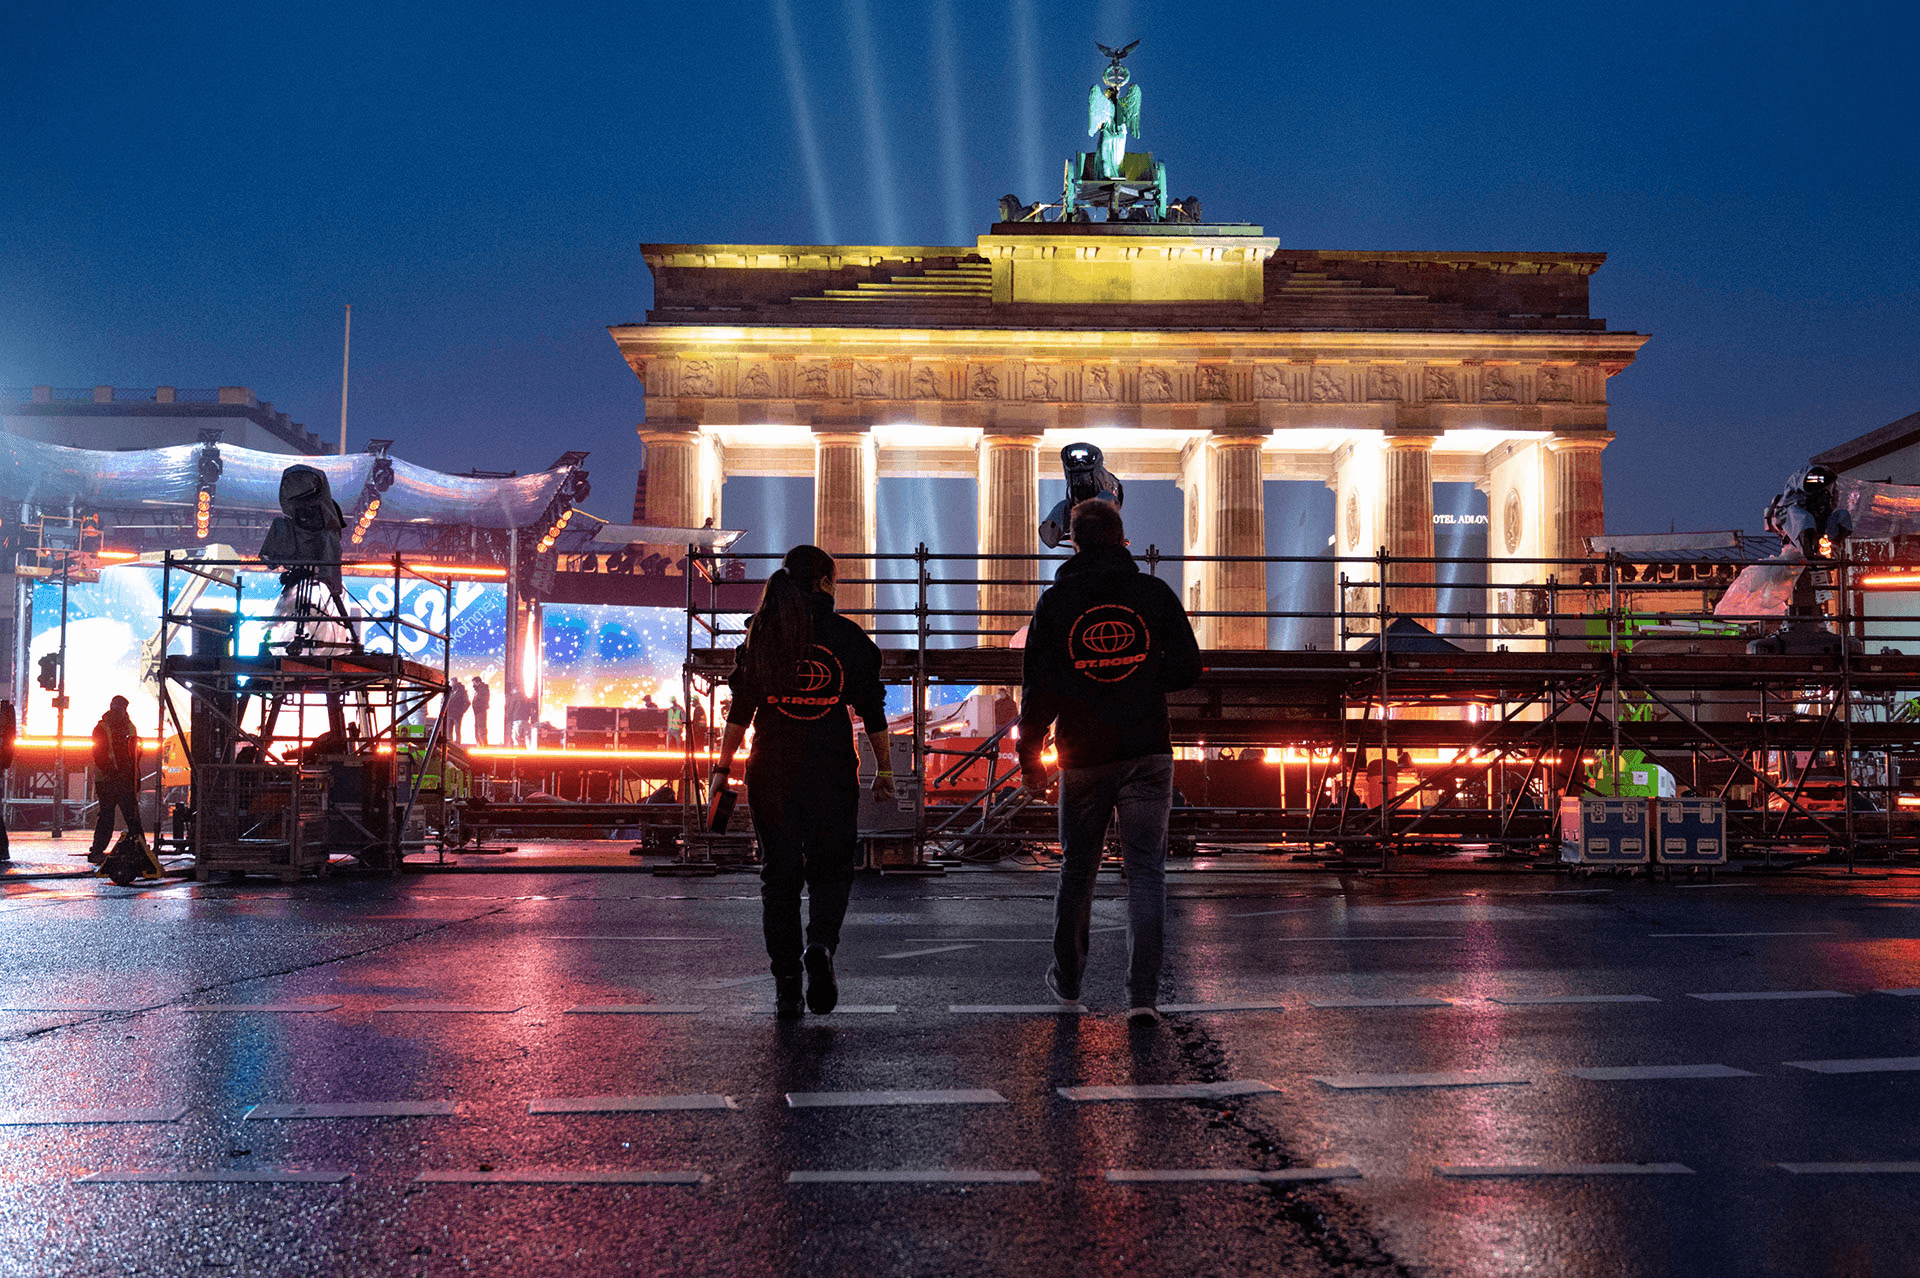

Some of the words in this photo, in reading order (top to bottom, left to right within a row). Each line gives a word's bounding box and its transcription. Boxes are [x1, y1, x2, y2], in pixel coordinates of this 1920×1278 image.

[1433, 515, 1456, 524] OTEL
[1458, 515, 1488, 524] ADLON
[430, 595, 500, 657] Wkommen
